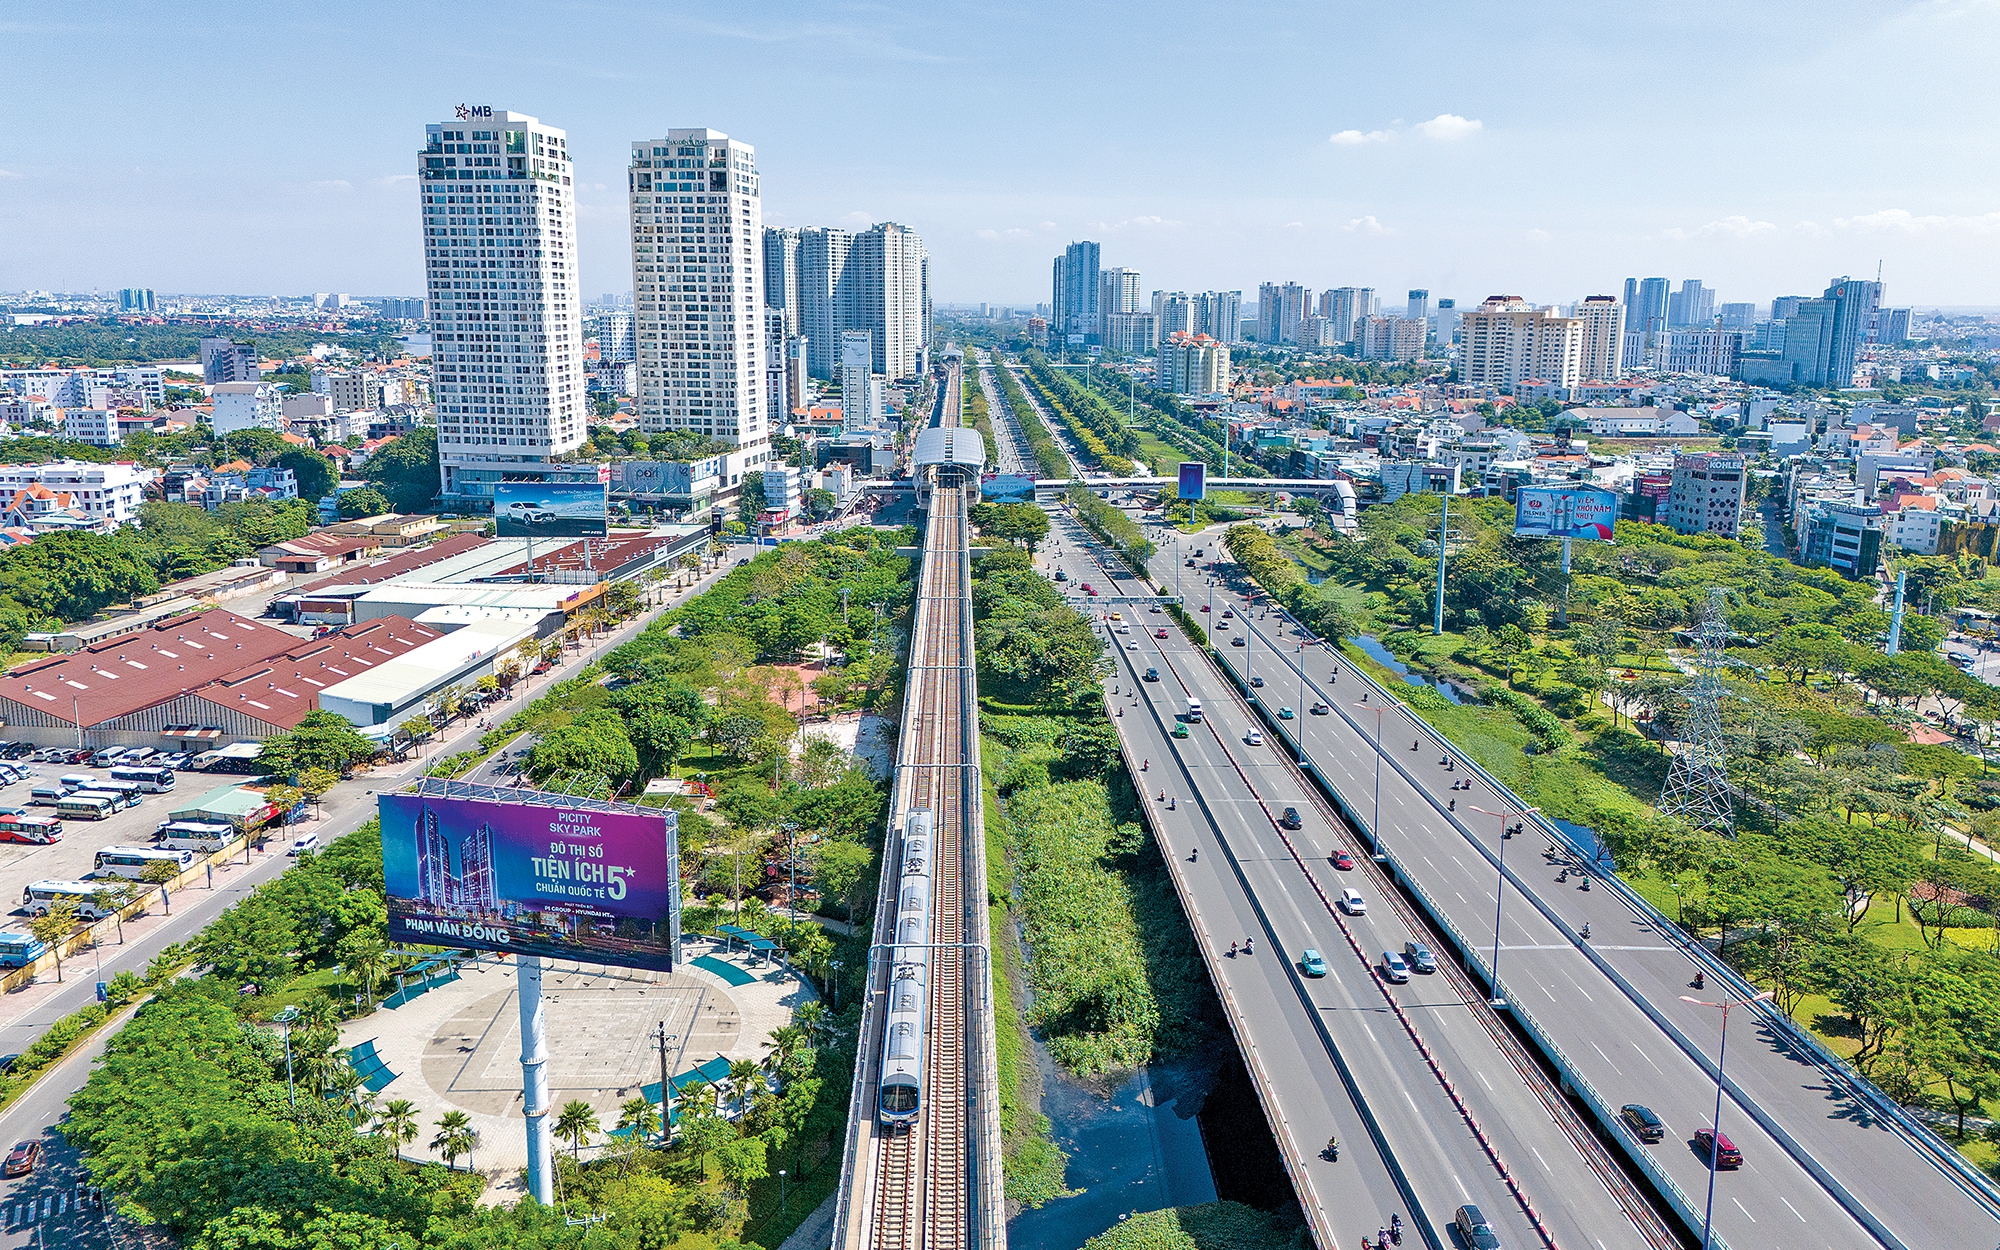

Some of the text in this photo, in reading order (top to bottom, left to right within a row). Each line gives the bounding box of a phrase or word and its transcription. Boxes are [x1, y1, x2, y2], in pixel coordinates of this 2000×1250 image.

[472, 105, 492, 118] MB
[1709, 461, 1743, 470] KOHLER
[558, 812, 592, 824] PICITY
[549, 823, 602, 837] SKY PARK
[550, 840, 604, 859] ĐÔ THỊ SỐ
[530, 854, 627, 901] TIỆN ÍCH 5
[568, 884, 592, 898] QUỐC
[594, 886, 605, 899] TẾ
[575, 909, 602, 917] HYUNDAI
[405, 918, 434, 935] PHẠM
[435, 919, 460, 937] VĂN
